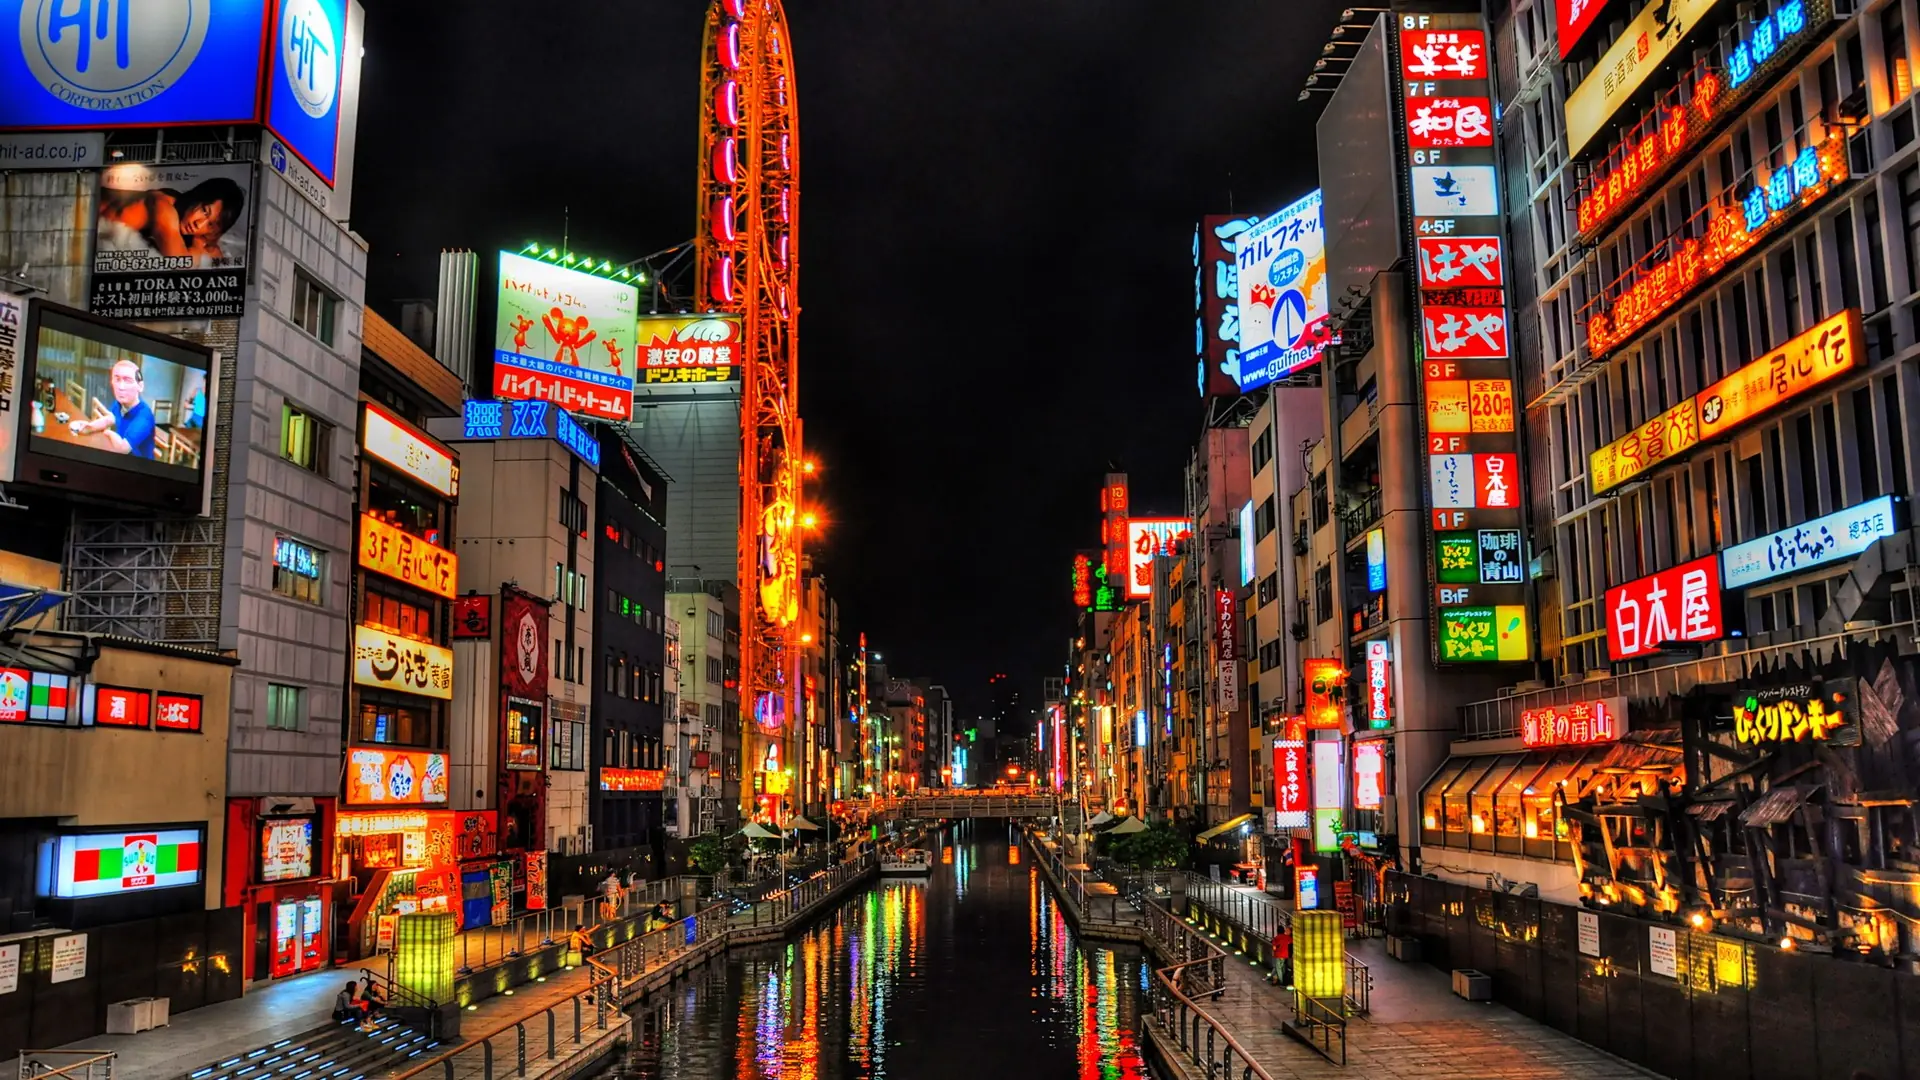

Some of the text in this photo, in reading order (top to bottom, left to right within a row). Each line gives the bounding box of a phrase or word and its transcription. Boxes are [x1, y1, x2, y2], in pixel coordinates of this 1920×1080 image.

[1403, 16, 1429, 29] 8F
[1604, 47, 1638, 100] 居酒家
[50, 80, 165, 110] CORPORATION
[1408, 83, 1436, 96] 7F
[1409, 106, 1491, 138] 和民
[1663, 75, 1719, 153] はや
[1432, 137, 1464, 145] わたみ
[1413, 150, 1441, 164] 6F
[1677, 215, 1732, 285] はや
[97, 257, 193, 271] TEL 06-6214-7845
[1421, 243, 1498, 283] はや
[135, 278, 176, 291] TORA
[180, 277, 202, 289] NO
[1273, 266, 1300, 285] システム
[1425, 313, 1503, 353] はや
[646, 346, 732, 366] 激安の殿堂
[1429, 363, 1456, 378] 3F
[1704, 396, 1721, 423] 3F
[1769, 324, 1846, 396] 居心伝
[500, 373, 626, 415] バイトルドットコム
[1474, 381, 1506, 392] 全品
[1428, 400, 1468, 413] 居心伝
[1472, 394, 1511, 417] 280円
[1432, 437, 1460, 451] 2F
[1485, 456, 1509, 506] 白木屋
[1438, 512, 1465, 527] 1F
[1849, 513, 1884, 540] 総本店
[368, 531, 390, 563] 3F
[1482, 534, 1518, 550] 珈琲
[1494, 549, 1507, 562] の
[1483, 561, 1520, 581] 青山
[1440, 588, 1469, 604] B1F
[1615, 569, 1717, 655] 白木屋
[1220, 593, 1233, 659] らーめん専門店
[1446, 618, 1491, 640] びっくり
[1445, 639, 1495, 658] ドンキー
[371, 639, 430, 689] うなぎ
[1758, 685, 1811, 698] ハンバーグレストラン
[110, 696, 127, 719] 酒
[157, 702, 189, 723] たばこ
[1732, 697, 1844, 746] びっくりドンキー
